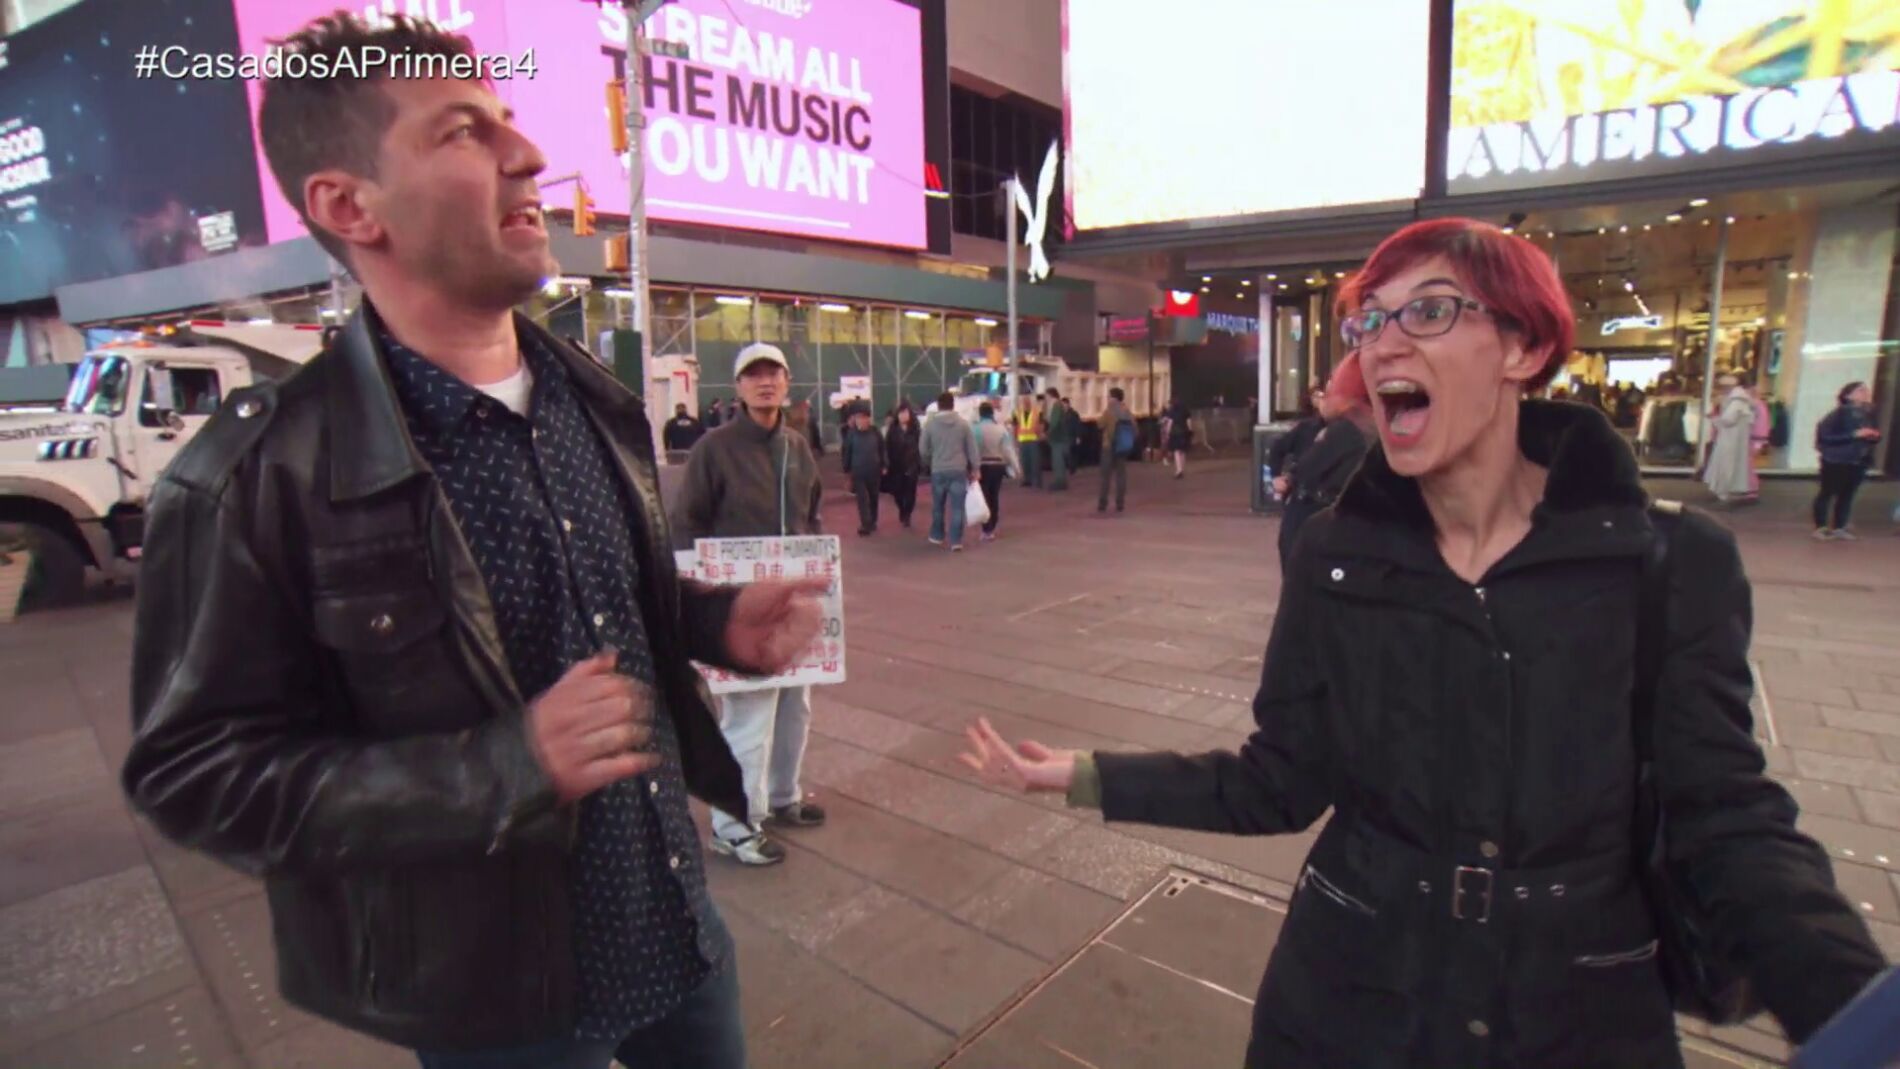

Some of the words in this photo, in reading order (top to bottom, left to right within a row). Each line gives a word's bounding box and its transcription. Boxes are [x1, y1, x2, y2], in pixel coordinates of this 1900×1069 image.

[600, 44, 717, 120] THE
[726, 75, 873, 151] MUSIC
[801, 46, 873, 105] ALL
[606, 108, 730, 183] OU
[735, 131, 875, 204] WANT
[1462, 72, 1900, 178] AMERICA
[704, 561, 737, 583] 和平
[753, 560, 784, 580] 自由
